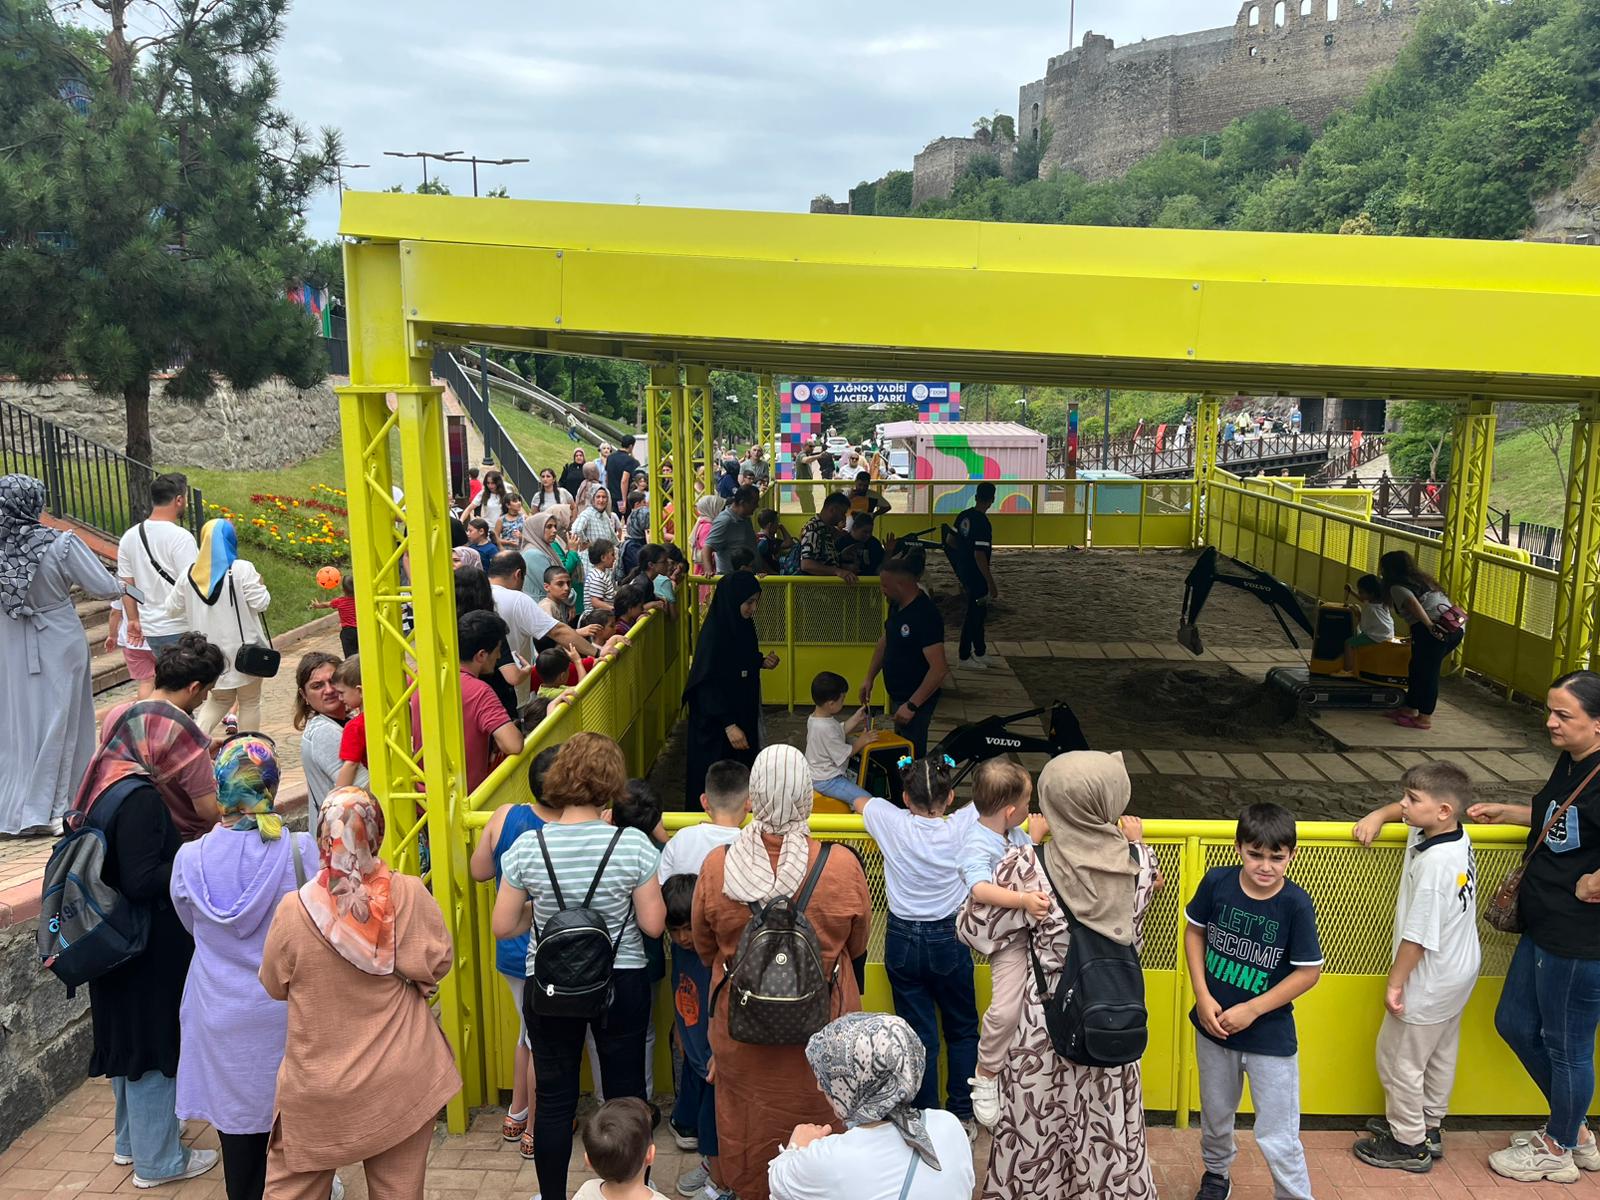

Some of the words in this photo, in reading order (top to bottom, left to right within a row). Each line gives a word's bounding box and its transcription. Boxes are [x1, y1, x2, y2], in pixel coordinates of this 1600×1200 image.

[833, 383, 874, 393] ZAĞNOS
[877, 383, 908, 393] VADİSİ
[834, 394, 876, 403] MACERA
[878, 394, 906, 403] PARKI
[1243, 580, 1272, 592] VOLVO
[985, 736, 1021, 748] VOLVO
[1217, 904, 1280, 945] LET'S
[1207, 921, 1286, 970] BECOME
[1205, 944, 1270, 995] WINNE
